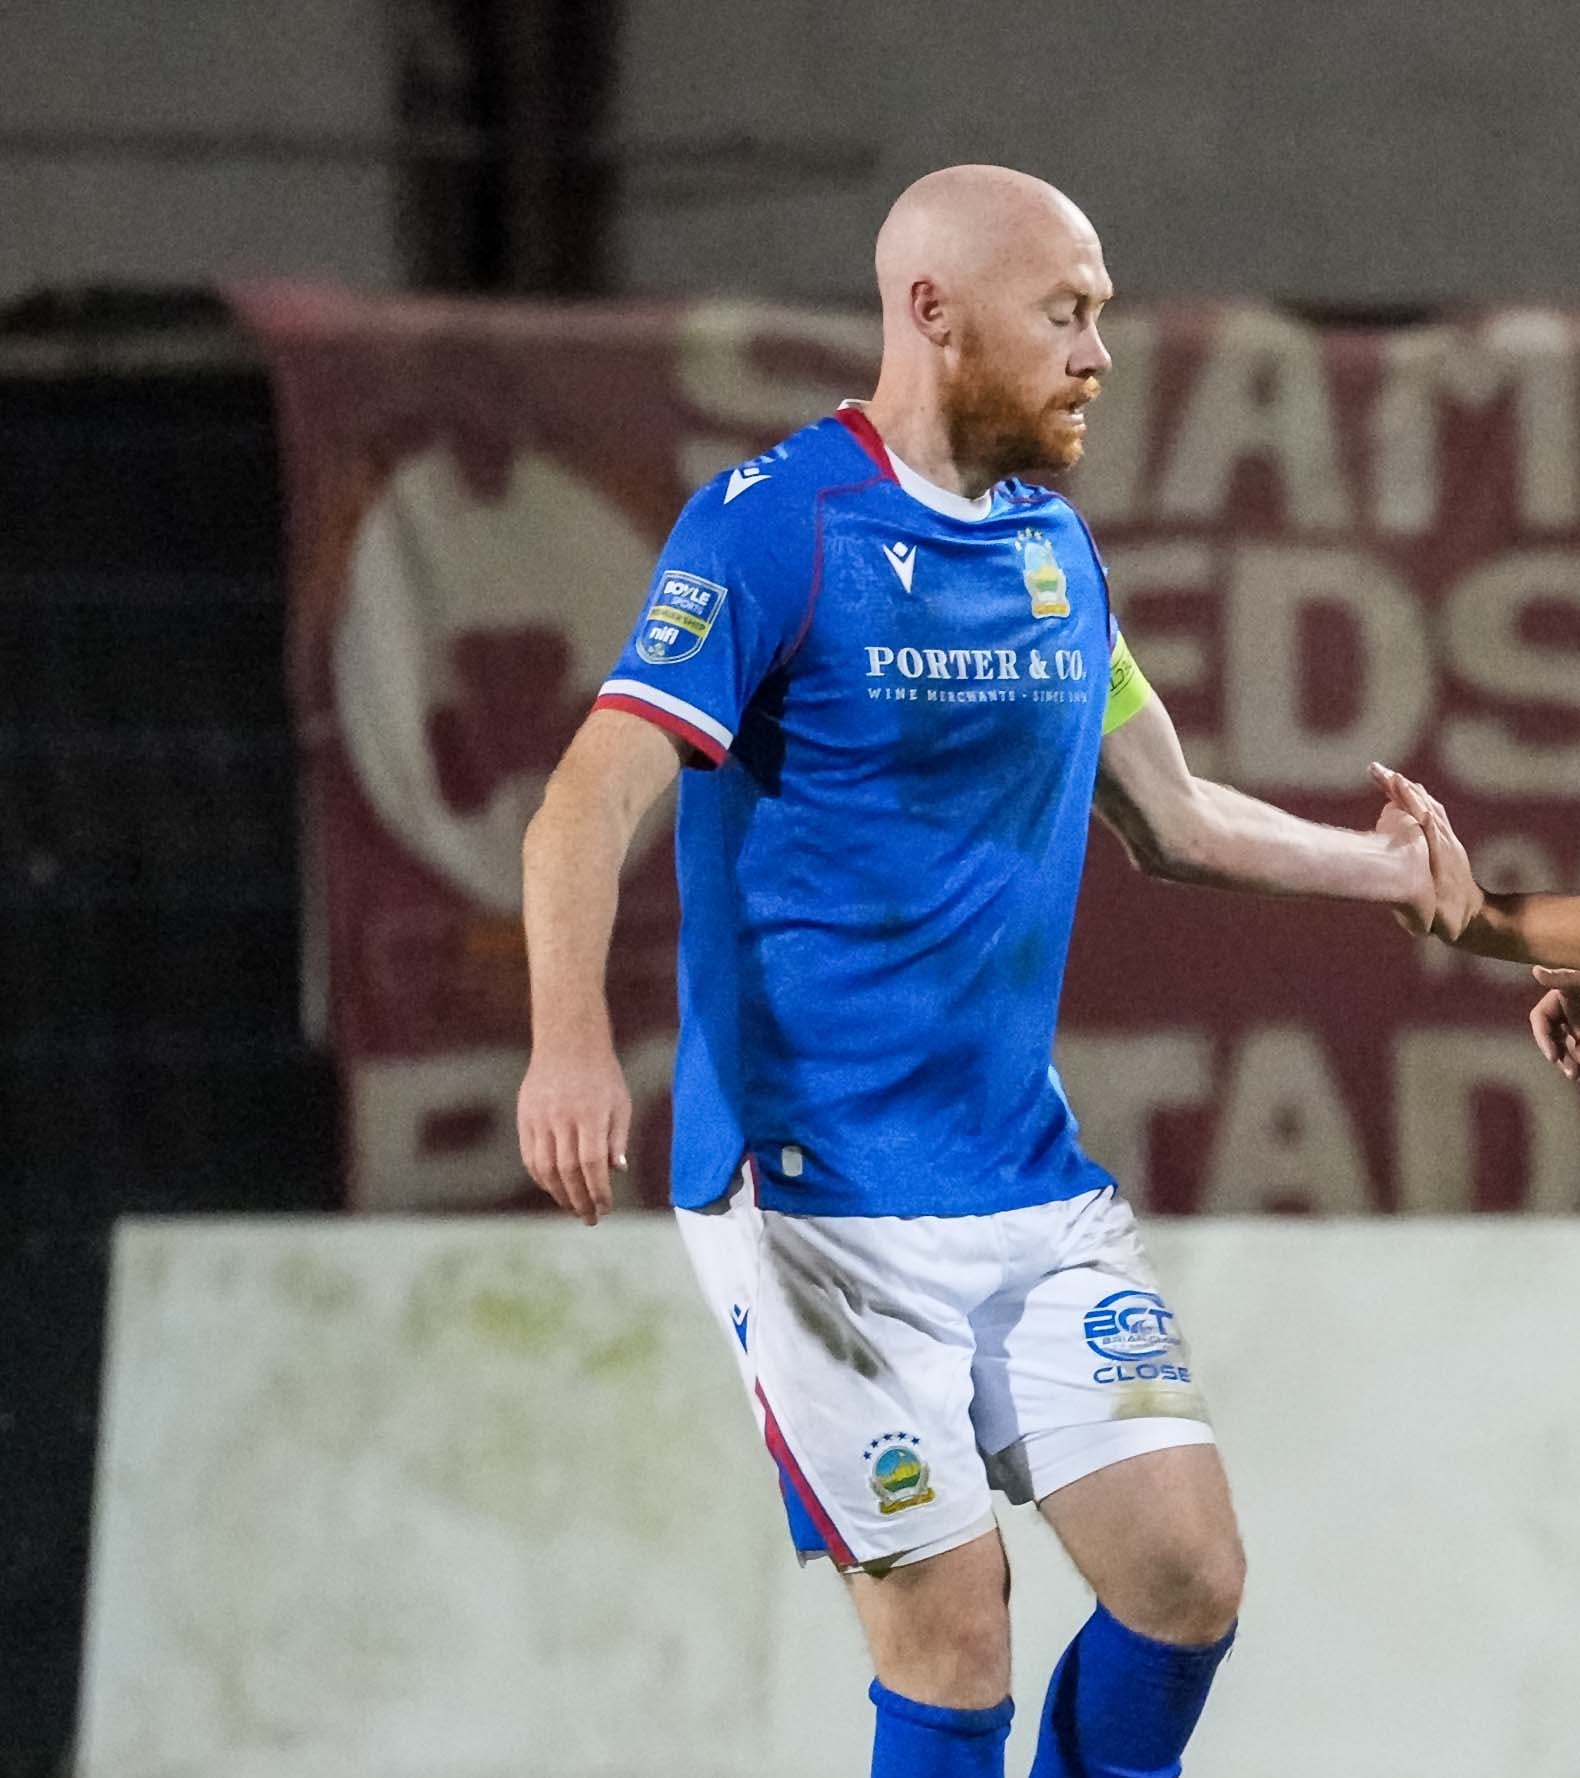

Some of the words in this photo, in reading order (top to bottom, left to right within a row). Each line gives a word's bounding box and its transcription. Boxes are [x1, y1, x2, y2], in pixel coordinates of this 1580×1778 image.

[864, 646, 1020, 680] PORTER
[1028, 649, 1050, 680] &
[1055, 649, 1087, 681] CO.
[867, 687, 918, 701] WINE
[927, 689, 1016, 703] MERCHANTS
[1093, 1363, 1191, 1384] CLOSE
